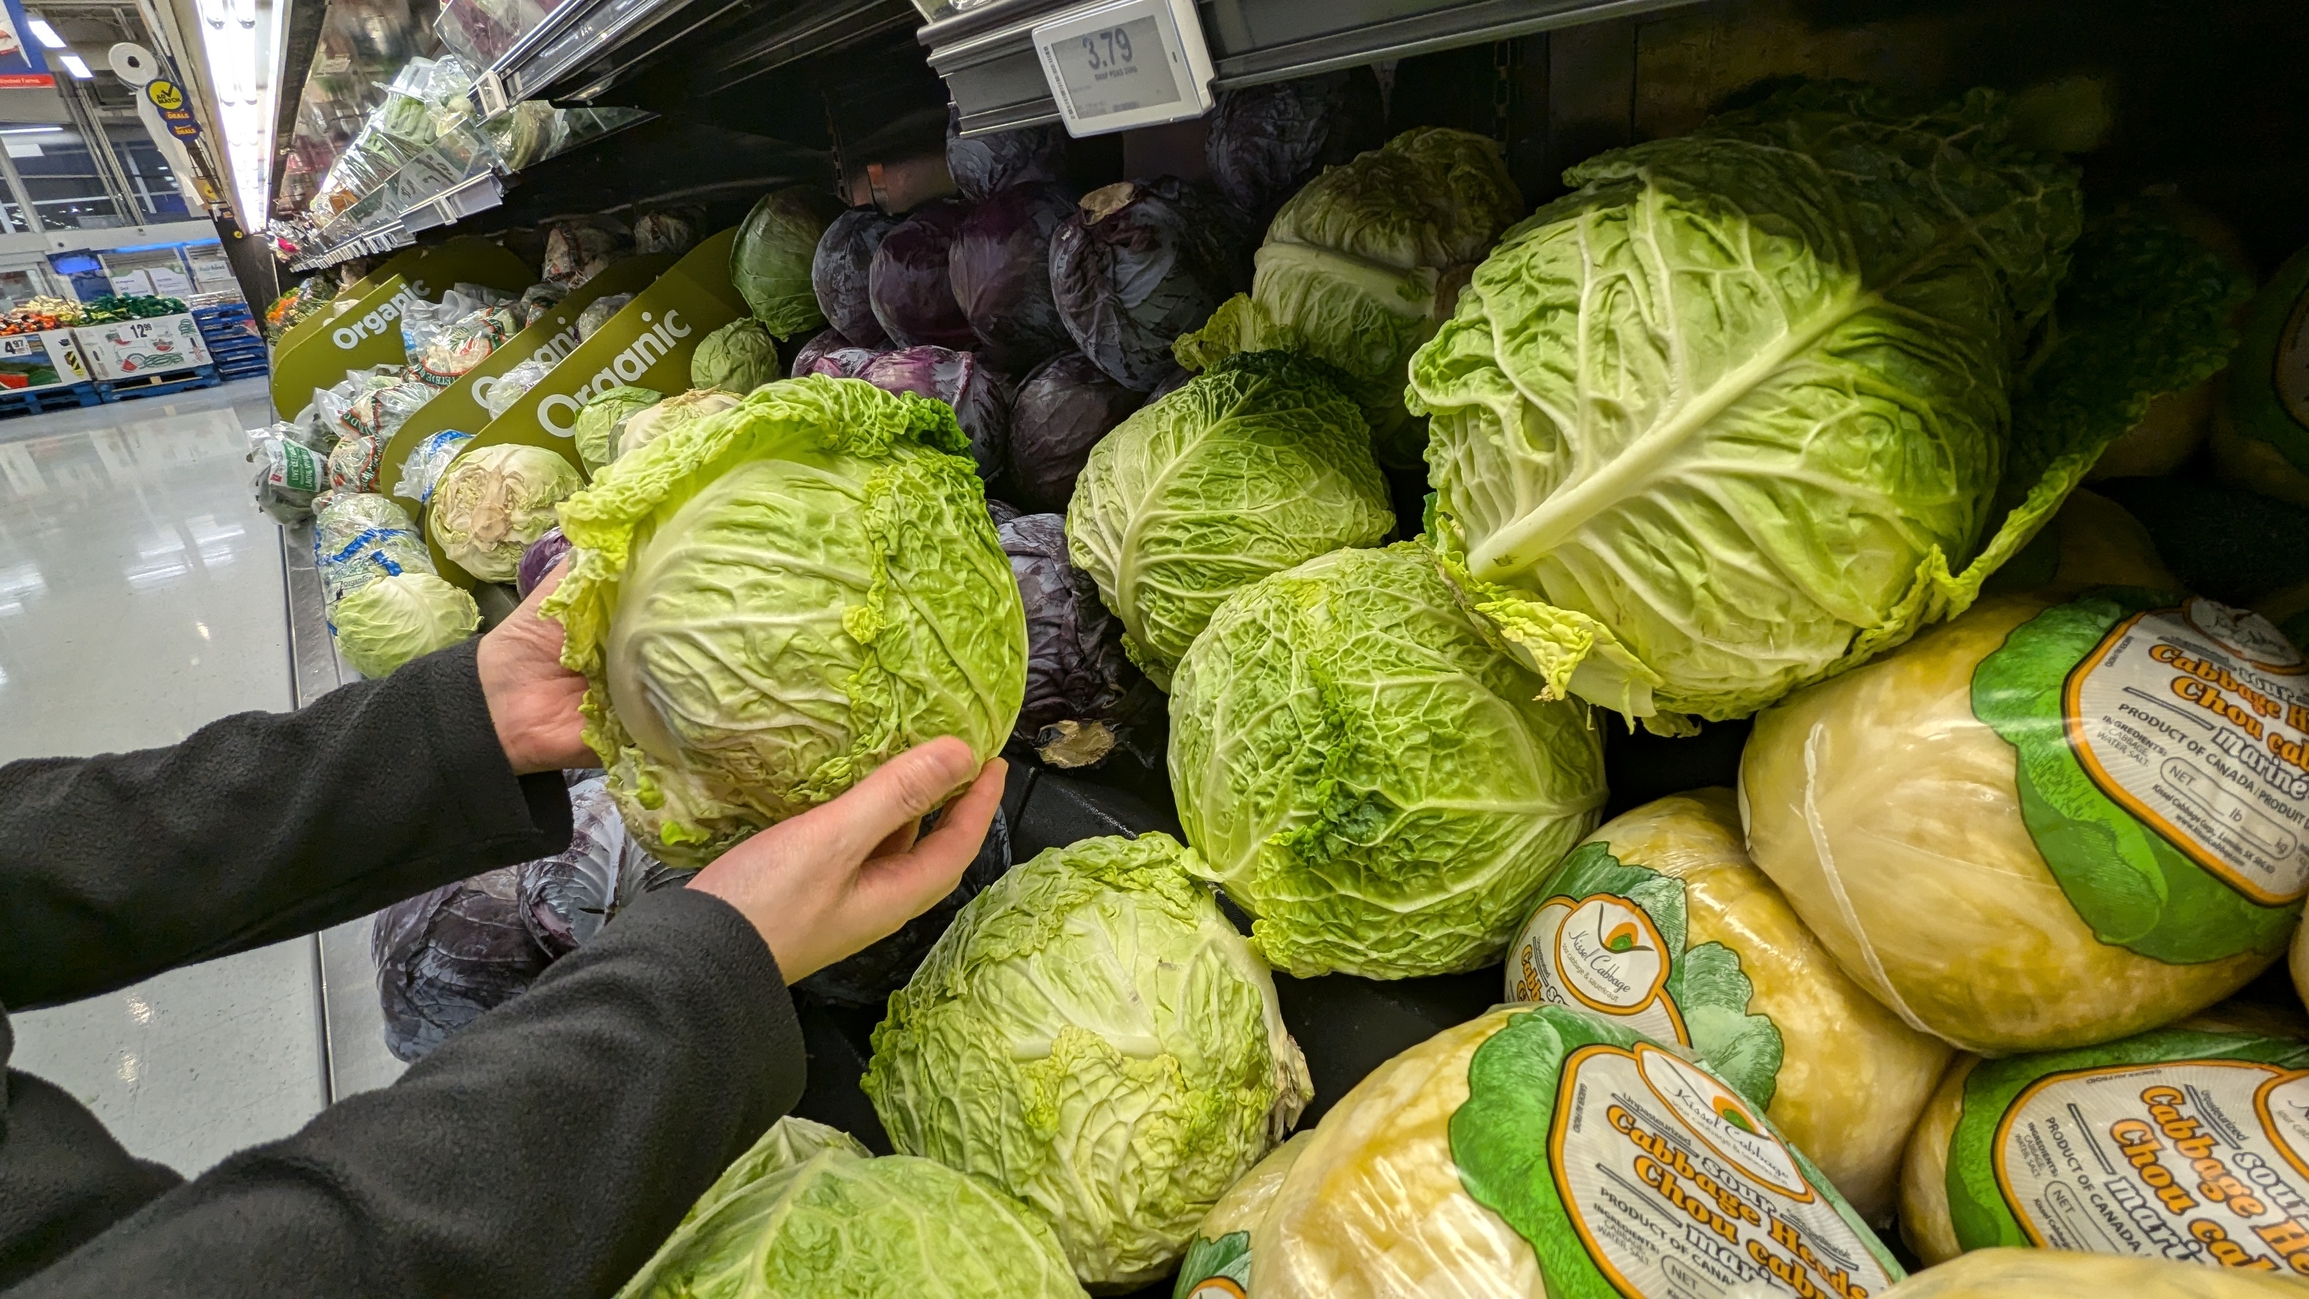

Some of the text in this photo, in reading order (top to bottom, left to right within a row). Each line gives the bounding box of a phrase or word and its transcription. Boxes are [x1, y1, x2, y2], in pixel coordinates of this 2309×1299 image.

[1082, 28, 1133, 70] 3.79
[333, 279, 431, 350] Organic
[537, 309, 692, 438] Organic
[2149, 644, 2282, 718] Cabbage
[2171, 676, 2264, 741] Chou
[2102, 715, 2167, 757] INGREDIENTS:
[2118, 703, 2188, 744] PRODUCT
[2187, 740, 2206, 757] OF
[2205, 753, 2255, 794] CANADA
[2258, 790, 2305, 824] PRODUIT
[2169, 765, 2197, 786] NET
[2228, 807, 2243, 822] lb
[2274, 837, 2288, 854] kg
[1521, 944, 1545, 1002] Cabb
[1567, 953, 1585, 976] cabbage
[1588, 977, 1619, 1002] sauerkraut
[1568, 930, 1631, 993] Kissel Cabbage
[1623, 1093, 1691, 1146] Unpasteurized
[1664, 1086, 1789, 1179] Kissel Cabbage
[2028, 1122, 2058, 1177] INGREDIENTS:
[2109, 1118, 2200, 1216] Chou
[2140, 1085, 2268, 1218] Cabbage
[1606, 1104, 1762, 1227] Cabbage
[1767, 1215, 1869, 1299] Heads
[1634, 1154, 1740, 1246] Chou
[1702, 1157, 1777, 1218] sour
[2046, 1117, 2143, 1252] PRODUCT OF CANADA
[2053, 1189, 2076, 1214] NET
[1593, 1202, 1660, 1254] INGREDIENTS:
[1600, 1186, 1736, 1286] PRODUCT OF CANA
[1671, 1265, 1699, 1290] NET
